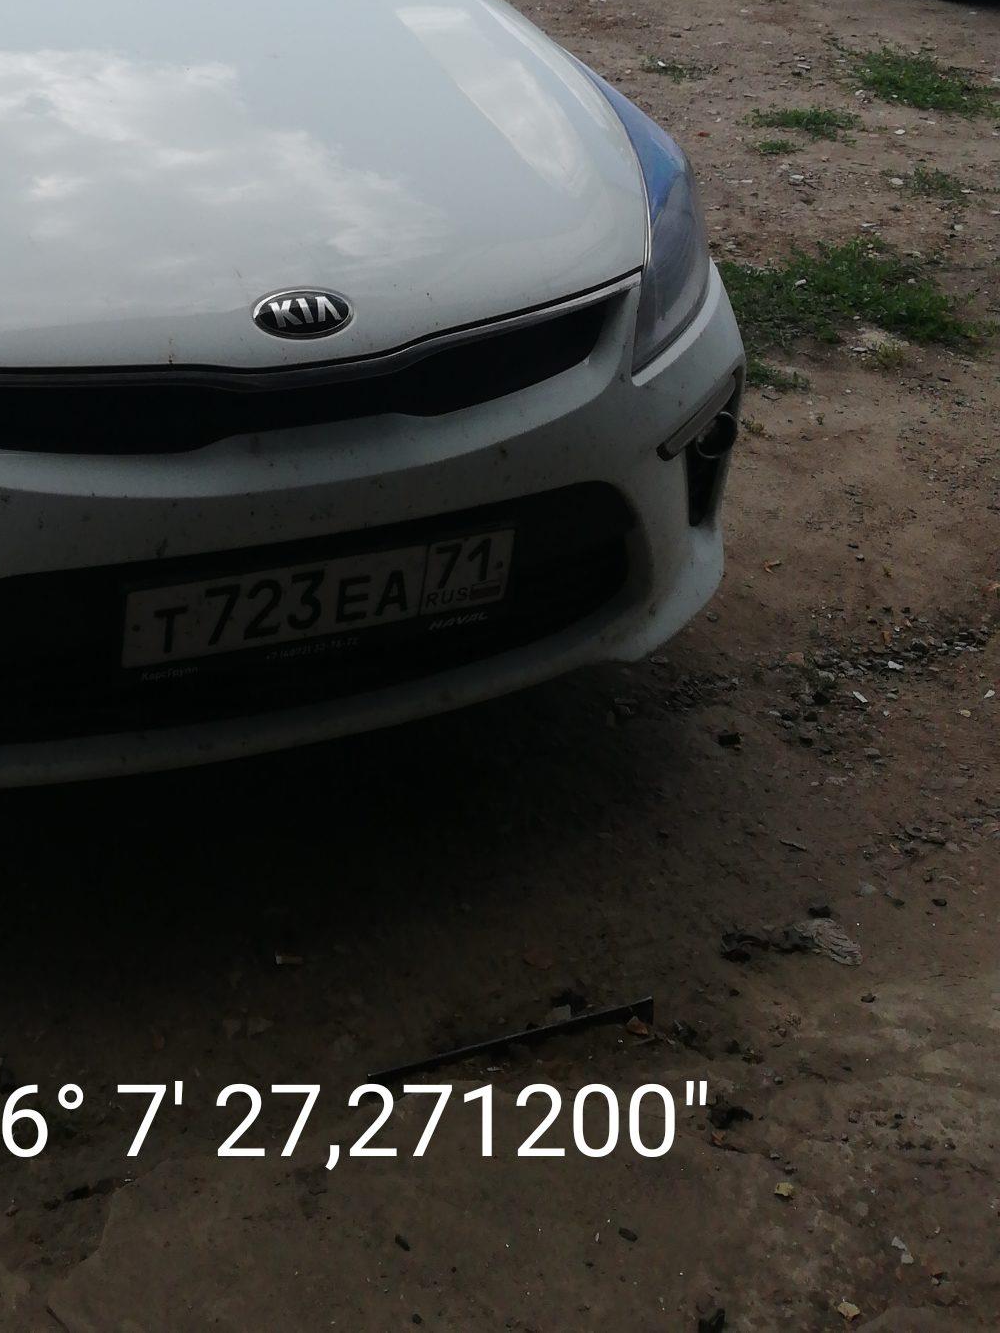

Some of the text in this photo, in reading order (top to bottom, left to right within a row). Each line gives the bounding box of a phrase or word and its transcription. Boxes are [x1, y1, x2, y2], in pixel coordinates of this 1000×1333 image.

[267, 295, 342, 328] KIA
[435, 538, 493, 589] 71
[425, 587, 468, 609] RUS
